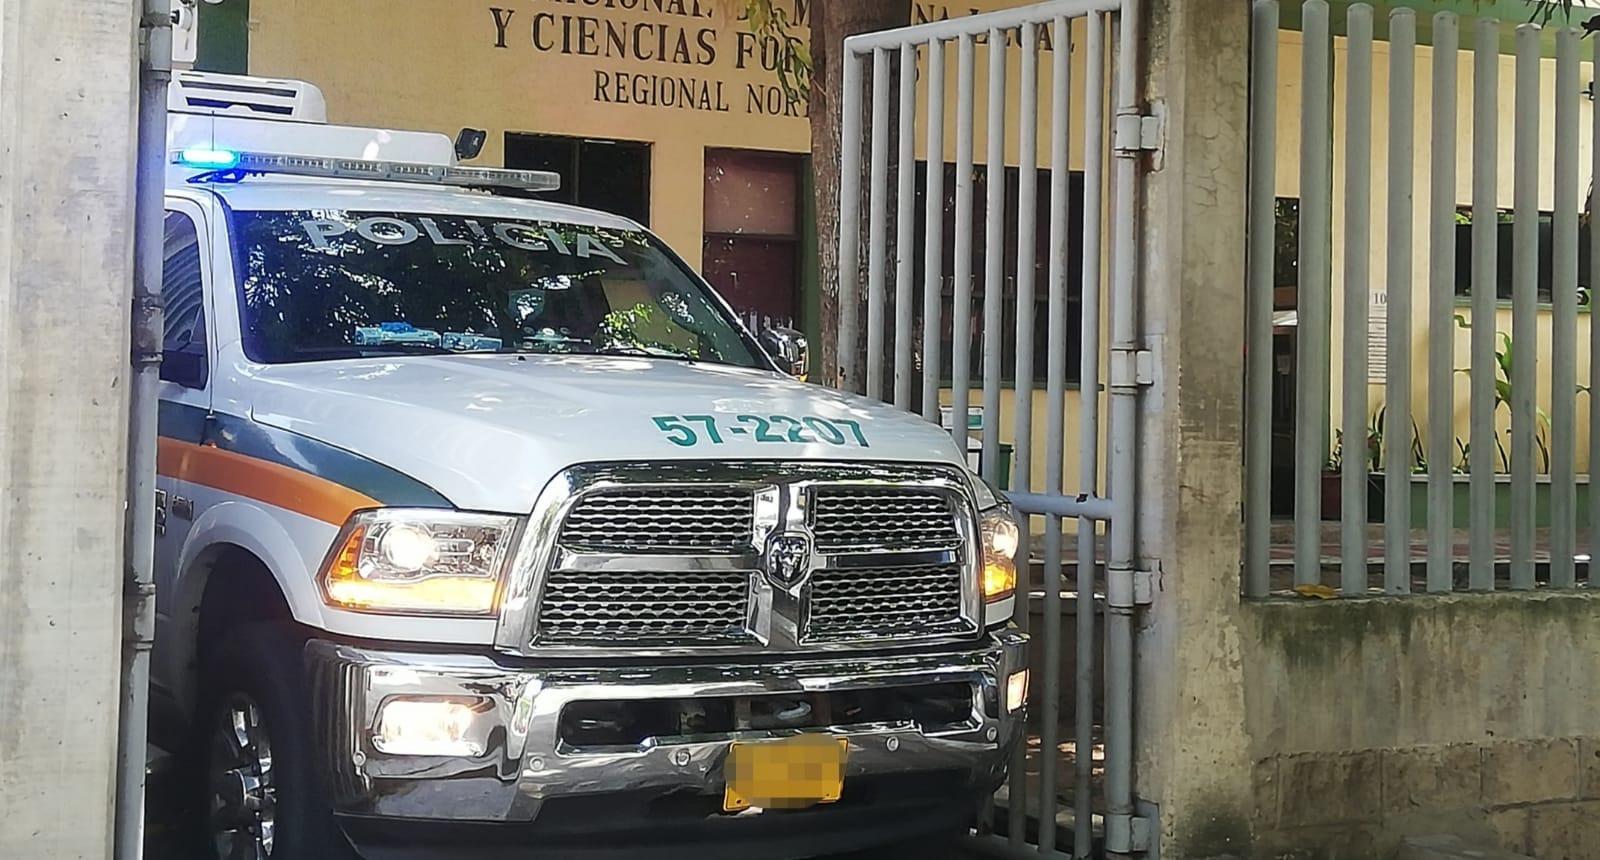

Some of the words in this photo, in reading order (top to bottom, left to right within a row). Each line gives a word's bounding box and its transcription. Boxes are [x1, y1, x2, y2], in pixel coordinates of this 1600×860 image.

[489, 7, 515, 49] Y
[531, 12, 717, 67] CIENCIAS
[593, 70, 729, 112] REGIONAL
[651, 415, 870, 448] 57-2207
